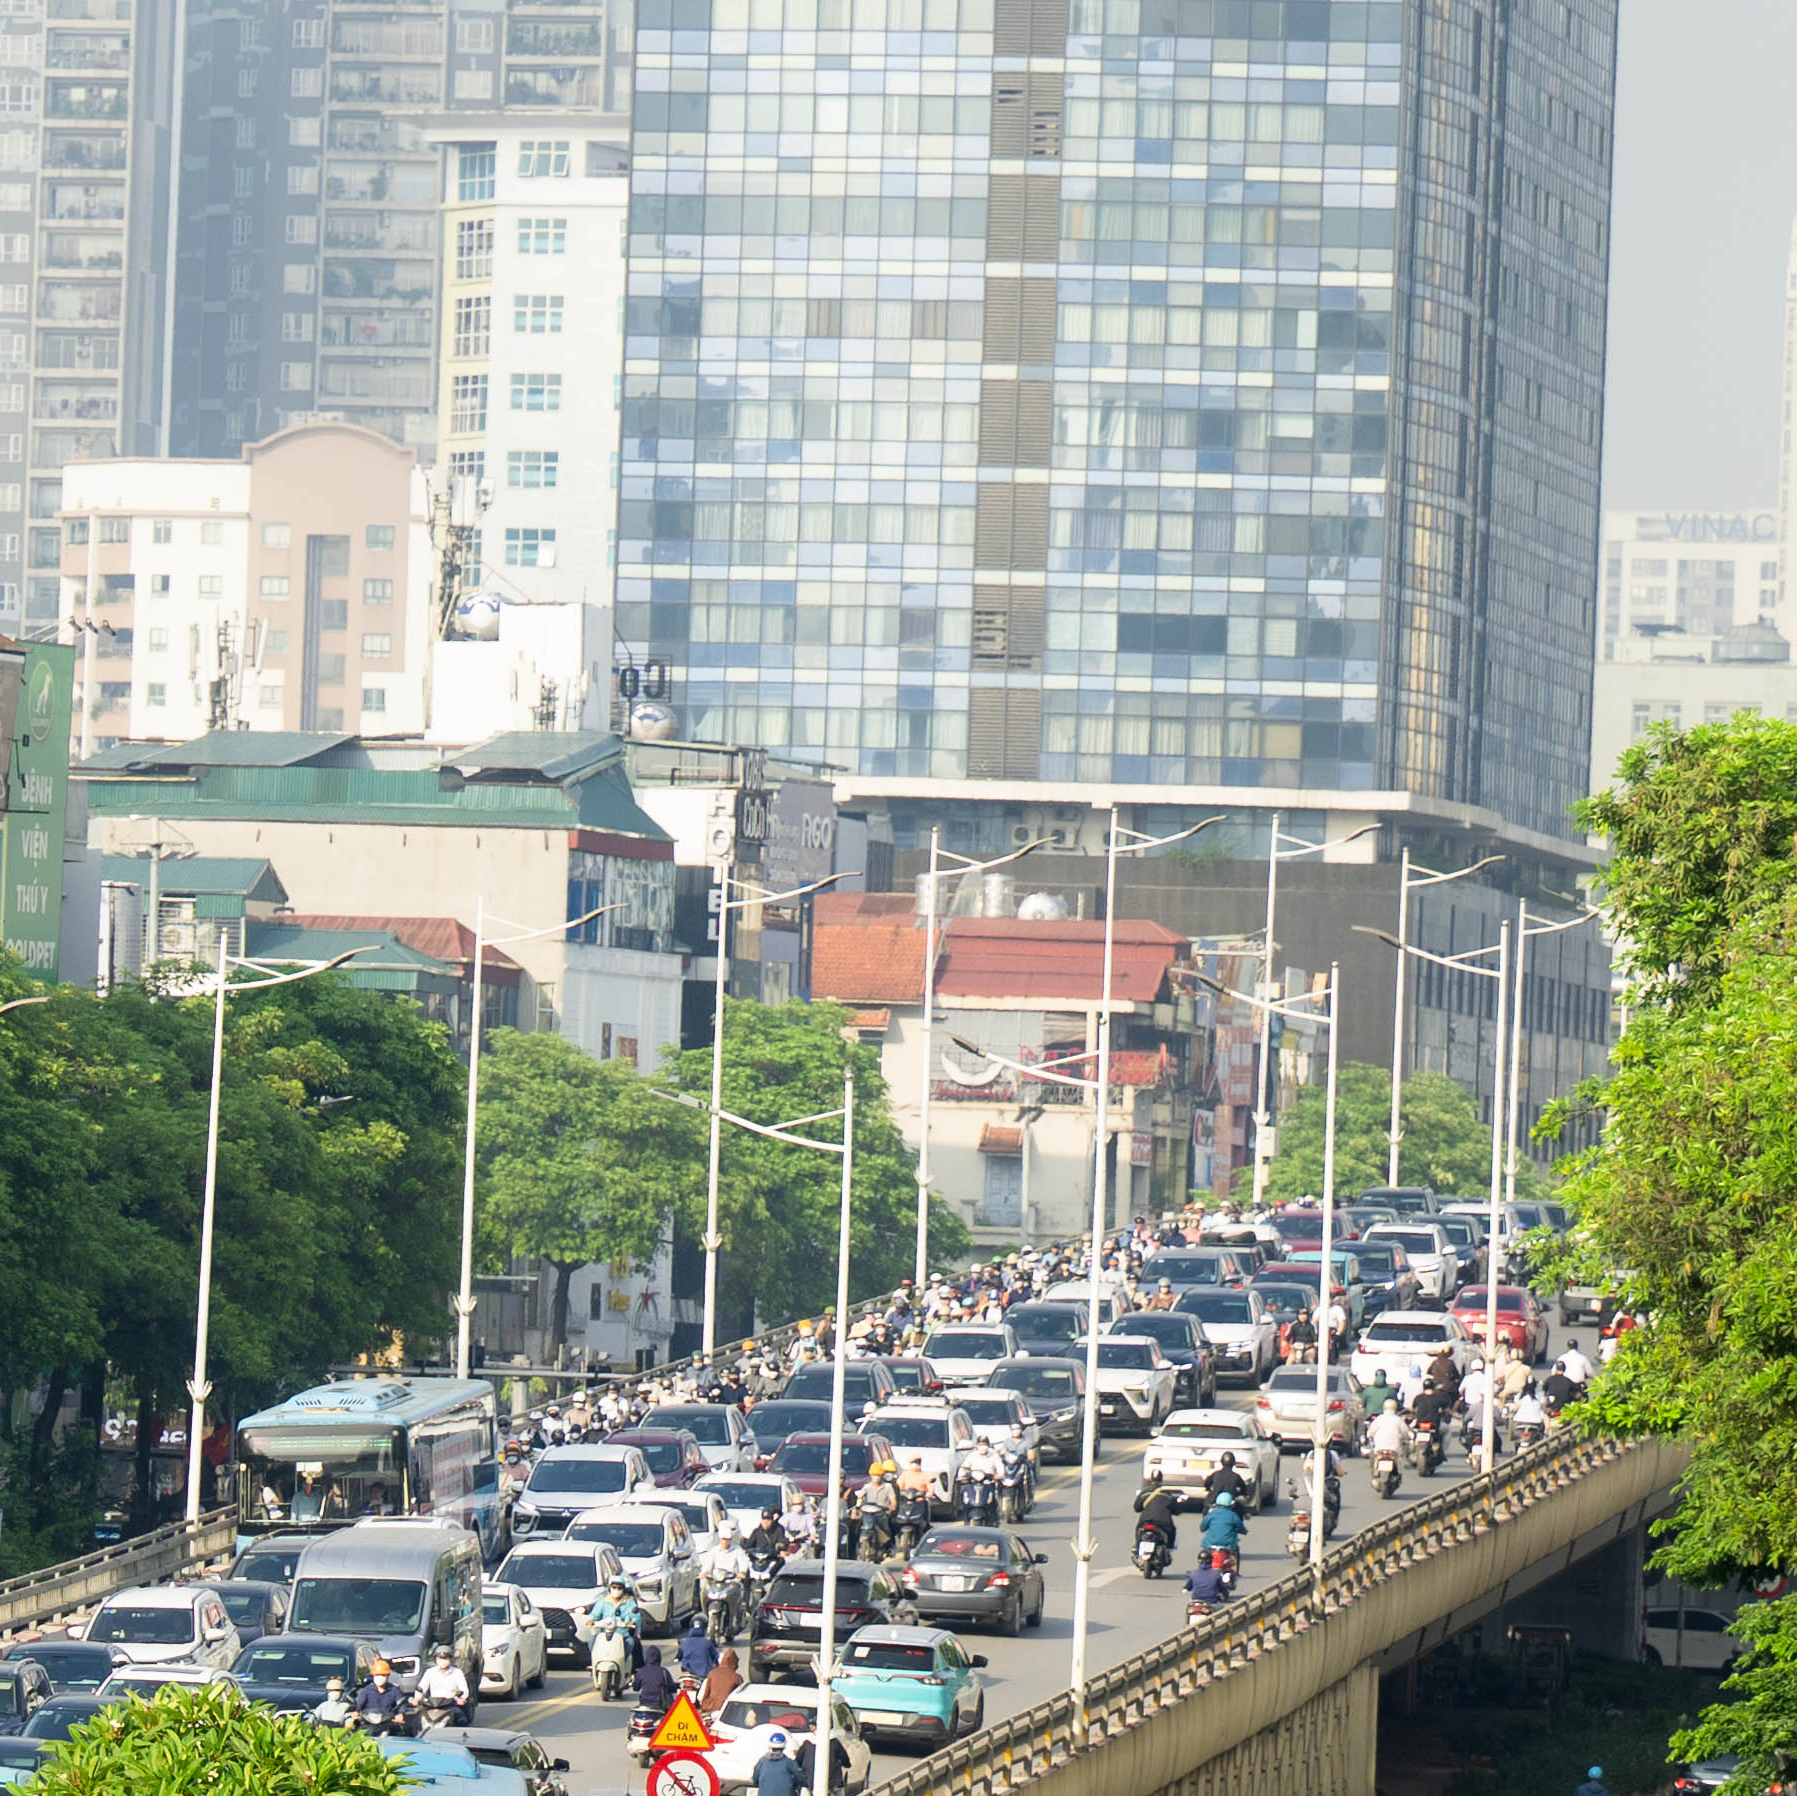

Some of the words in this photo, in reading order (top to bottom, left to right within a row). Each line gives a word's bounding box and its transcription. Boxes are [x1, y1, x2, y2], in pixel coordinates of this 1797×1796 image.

[21, 822, 49, 868] VIỆN
[16, 878, 39, 914] THÚ
[40, 886, 49, 914] Y
